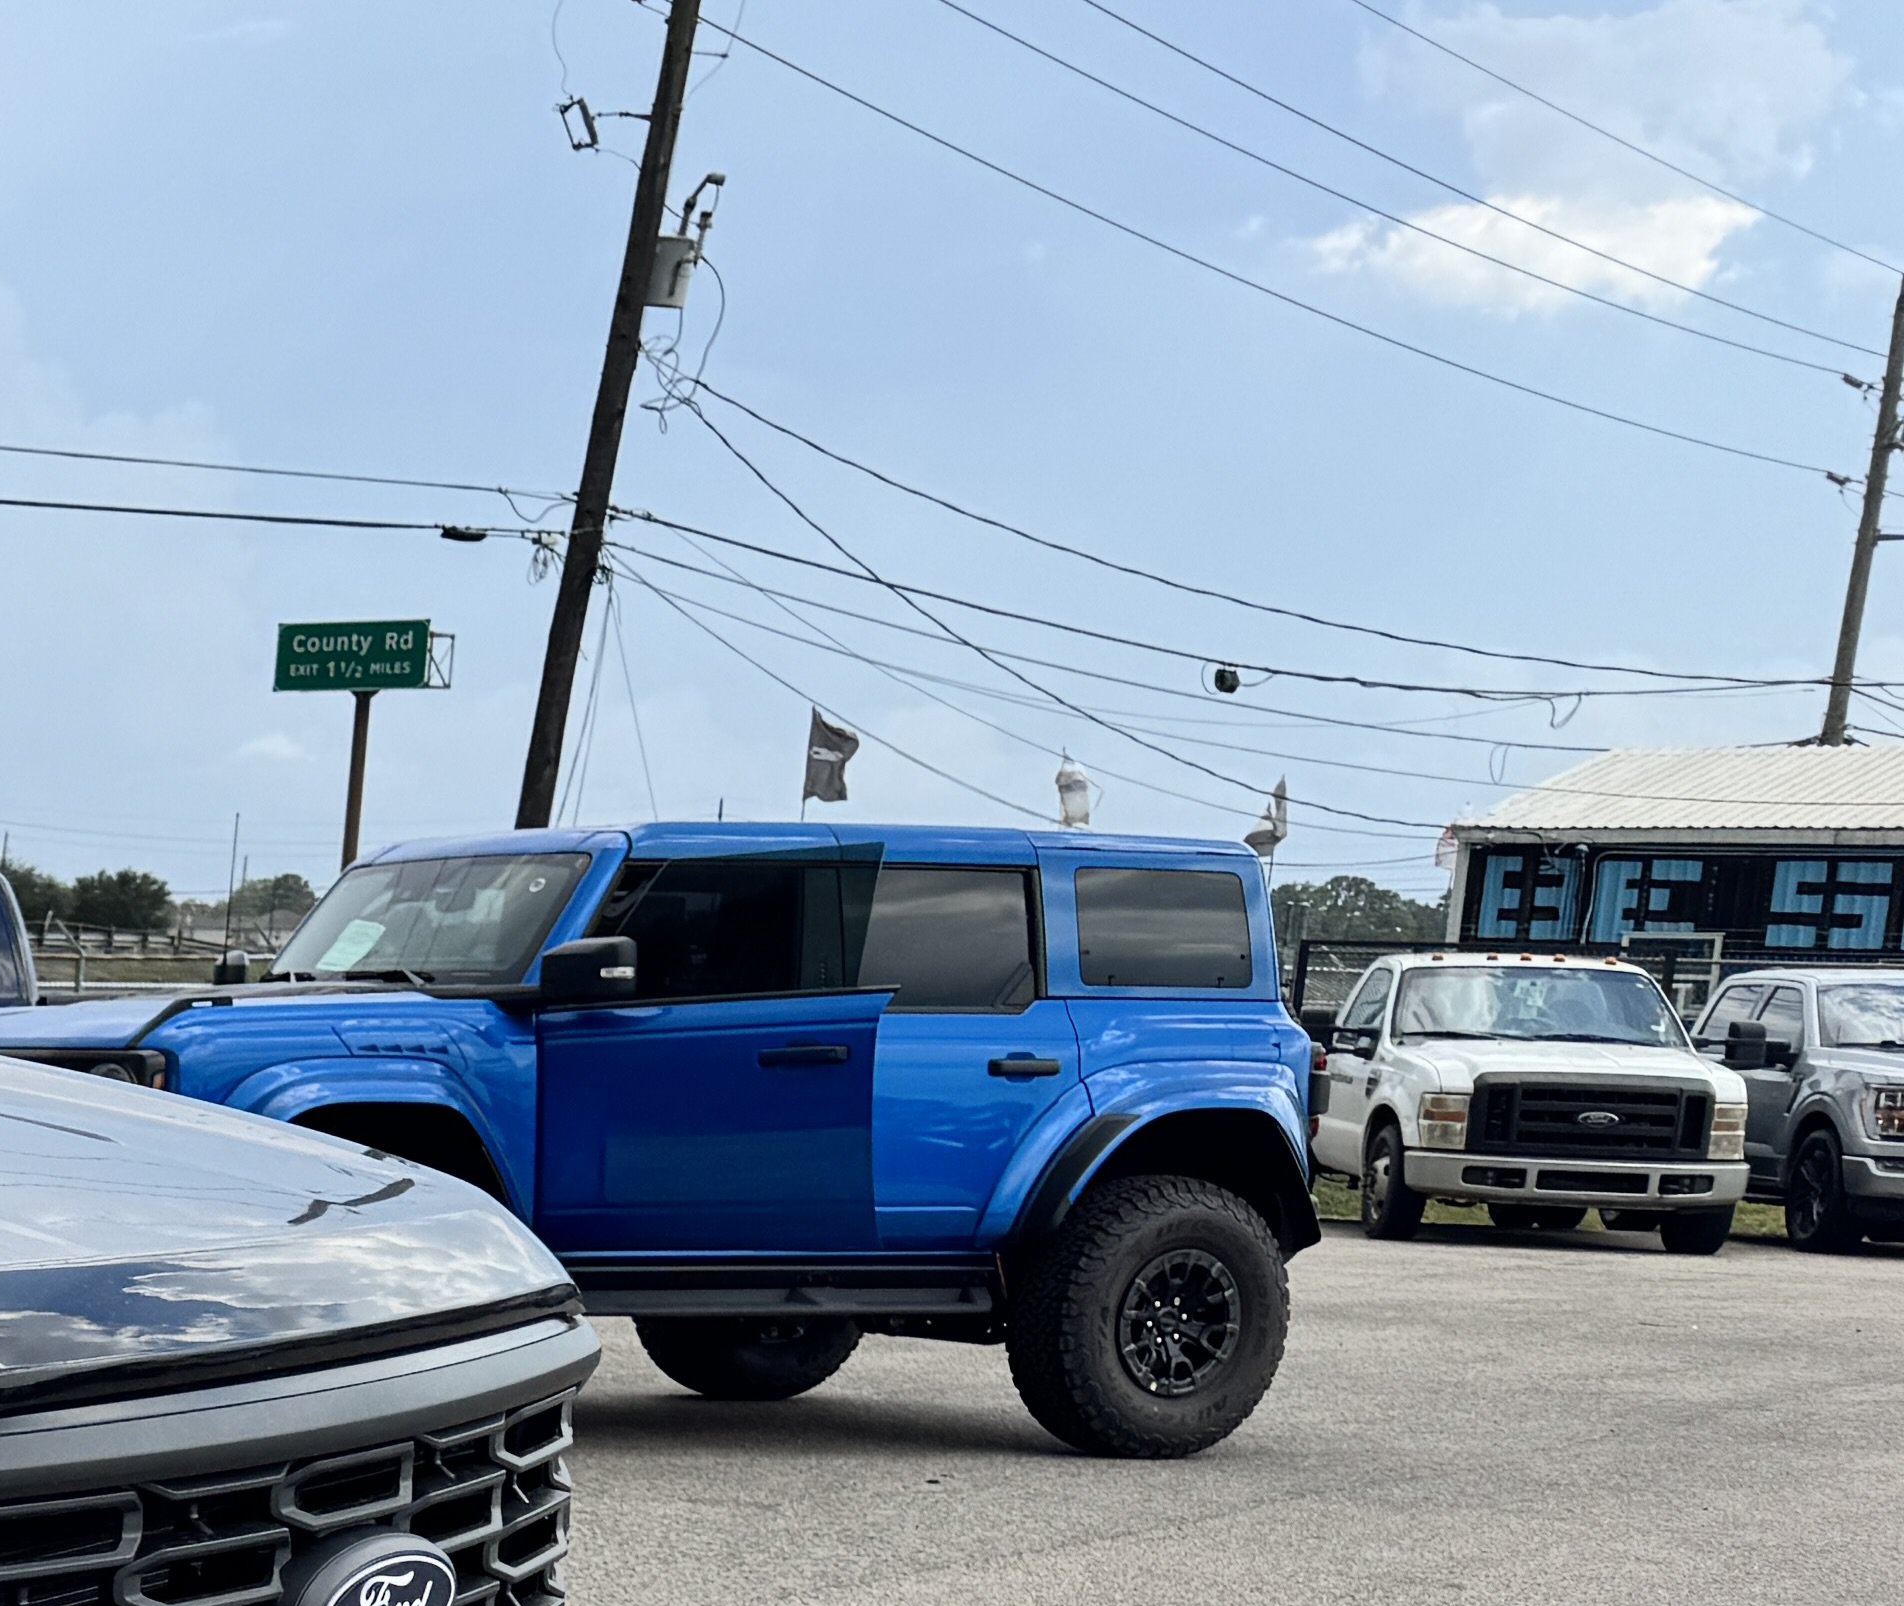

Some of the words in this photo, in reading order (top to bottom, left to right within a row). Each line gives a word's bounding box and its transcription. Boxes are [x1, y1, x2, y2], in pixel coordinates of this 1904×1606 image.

[292, 633, 373, 656] County
[385, 630, 414, 650] Rd
[289, 664, 319, 677] EXIT
[369, 661, 412, 675] MILES
[1765, 860, 1904, 950] S
